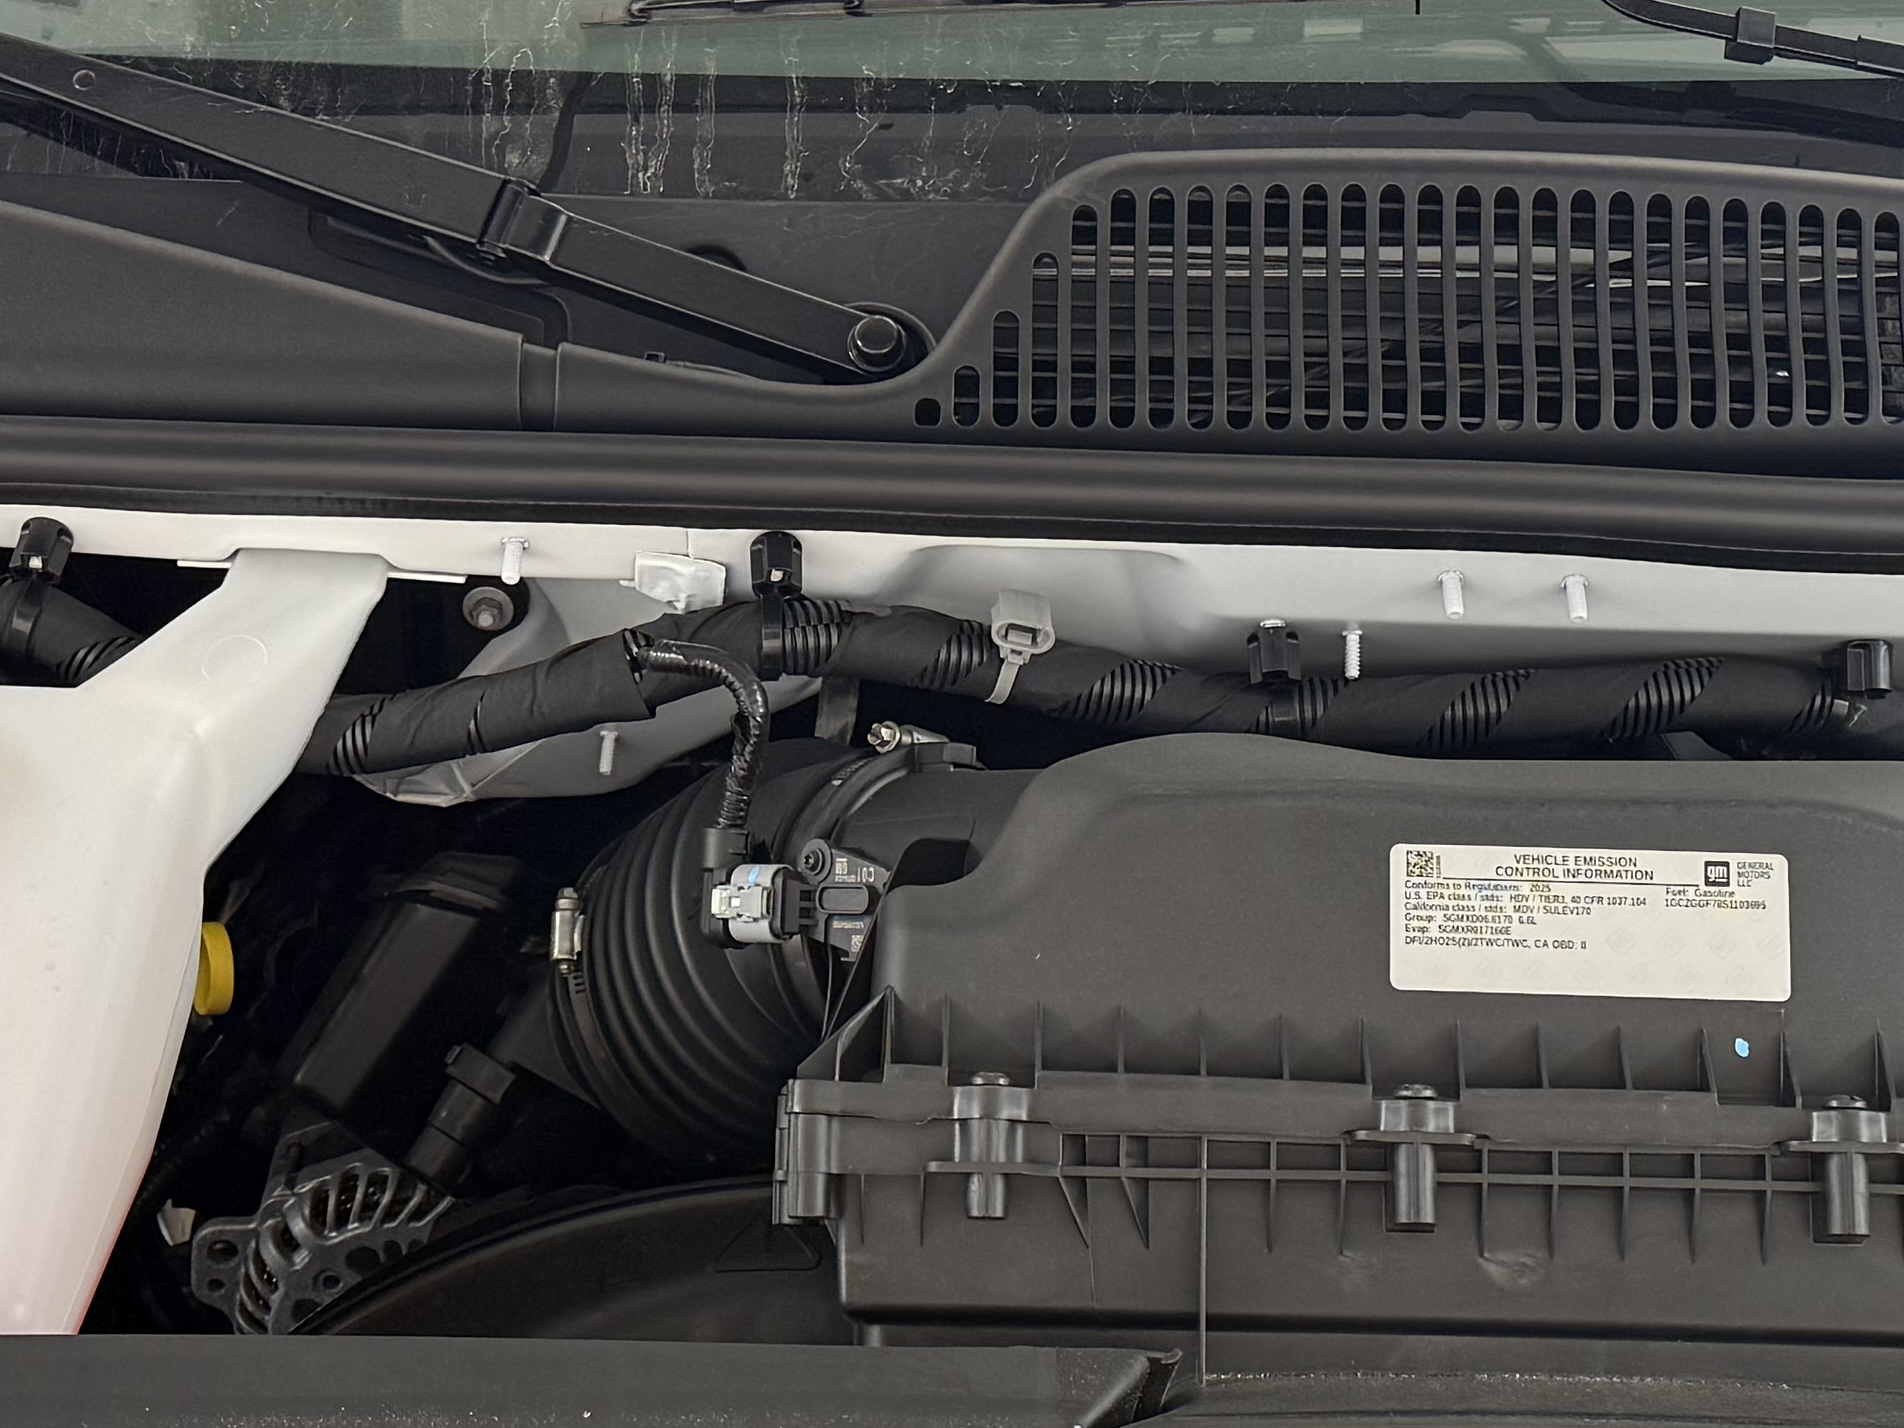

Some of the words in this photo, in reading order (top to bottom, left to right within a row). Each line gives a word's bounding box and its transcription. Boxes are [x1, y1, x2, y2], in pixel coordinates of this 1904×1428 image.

[1513, 853, 1570, 866] VEHICLE
[1574, 854, 1638, 868] EMISSION
[1736, 861, 1774, 871] GENERAL
[1495, 865, 1559, 879] CONTROL
[1562, 867, 1654, 881] INFORMATION
[1736, 871, 1771, 880] MOTORS
[1404, 879, 1450, 890] Conforms
[1452, 881, 1462, 890] to
[1426, 891, 1446, 901] EPA
[1693, 887, 1736, 898] Gasoline
[1404, 912, 1437, 924] Group:
[1534, 939, 1549, 949] CA
